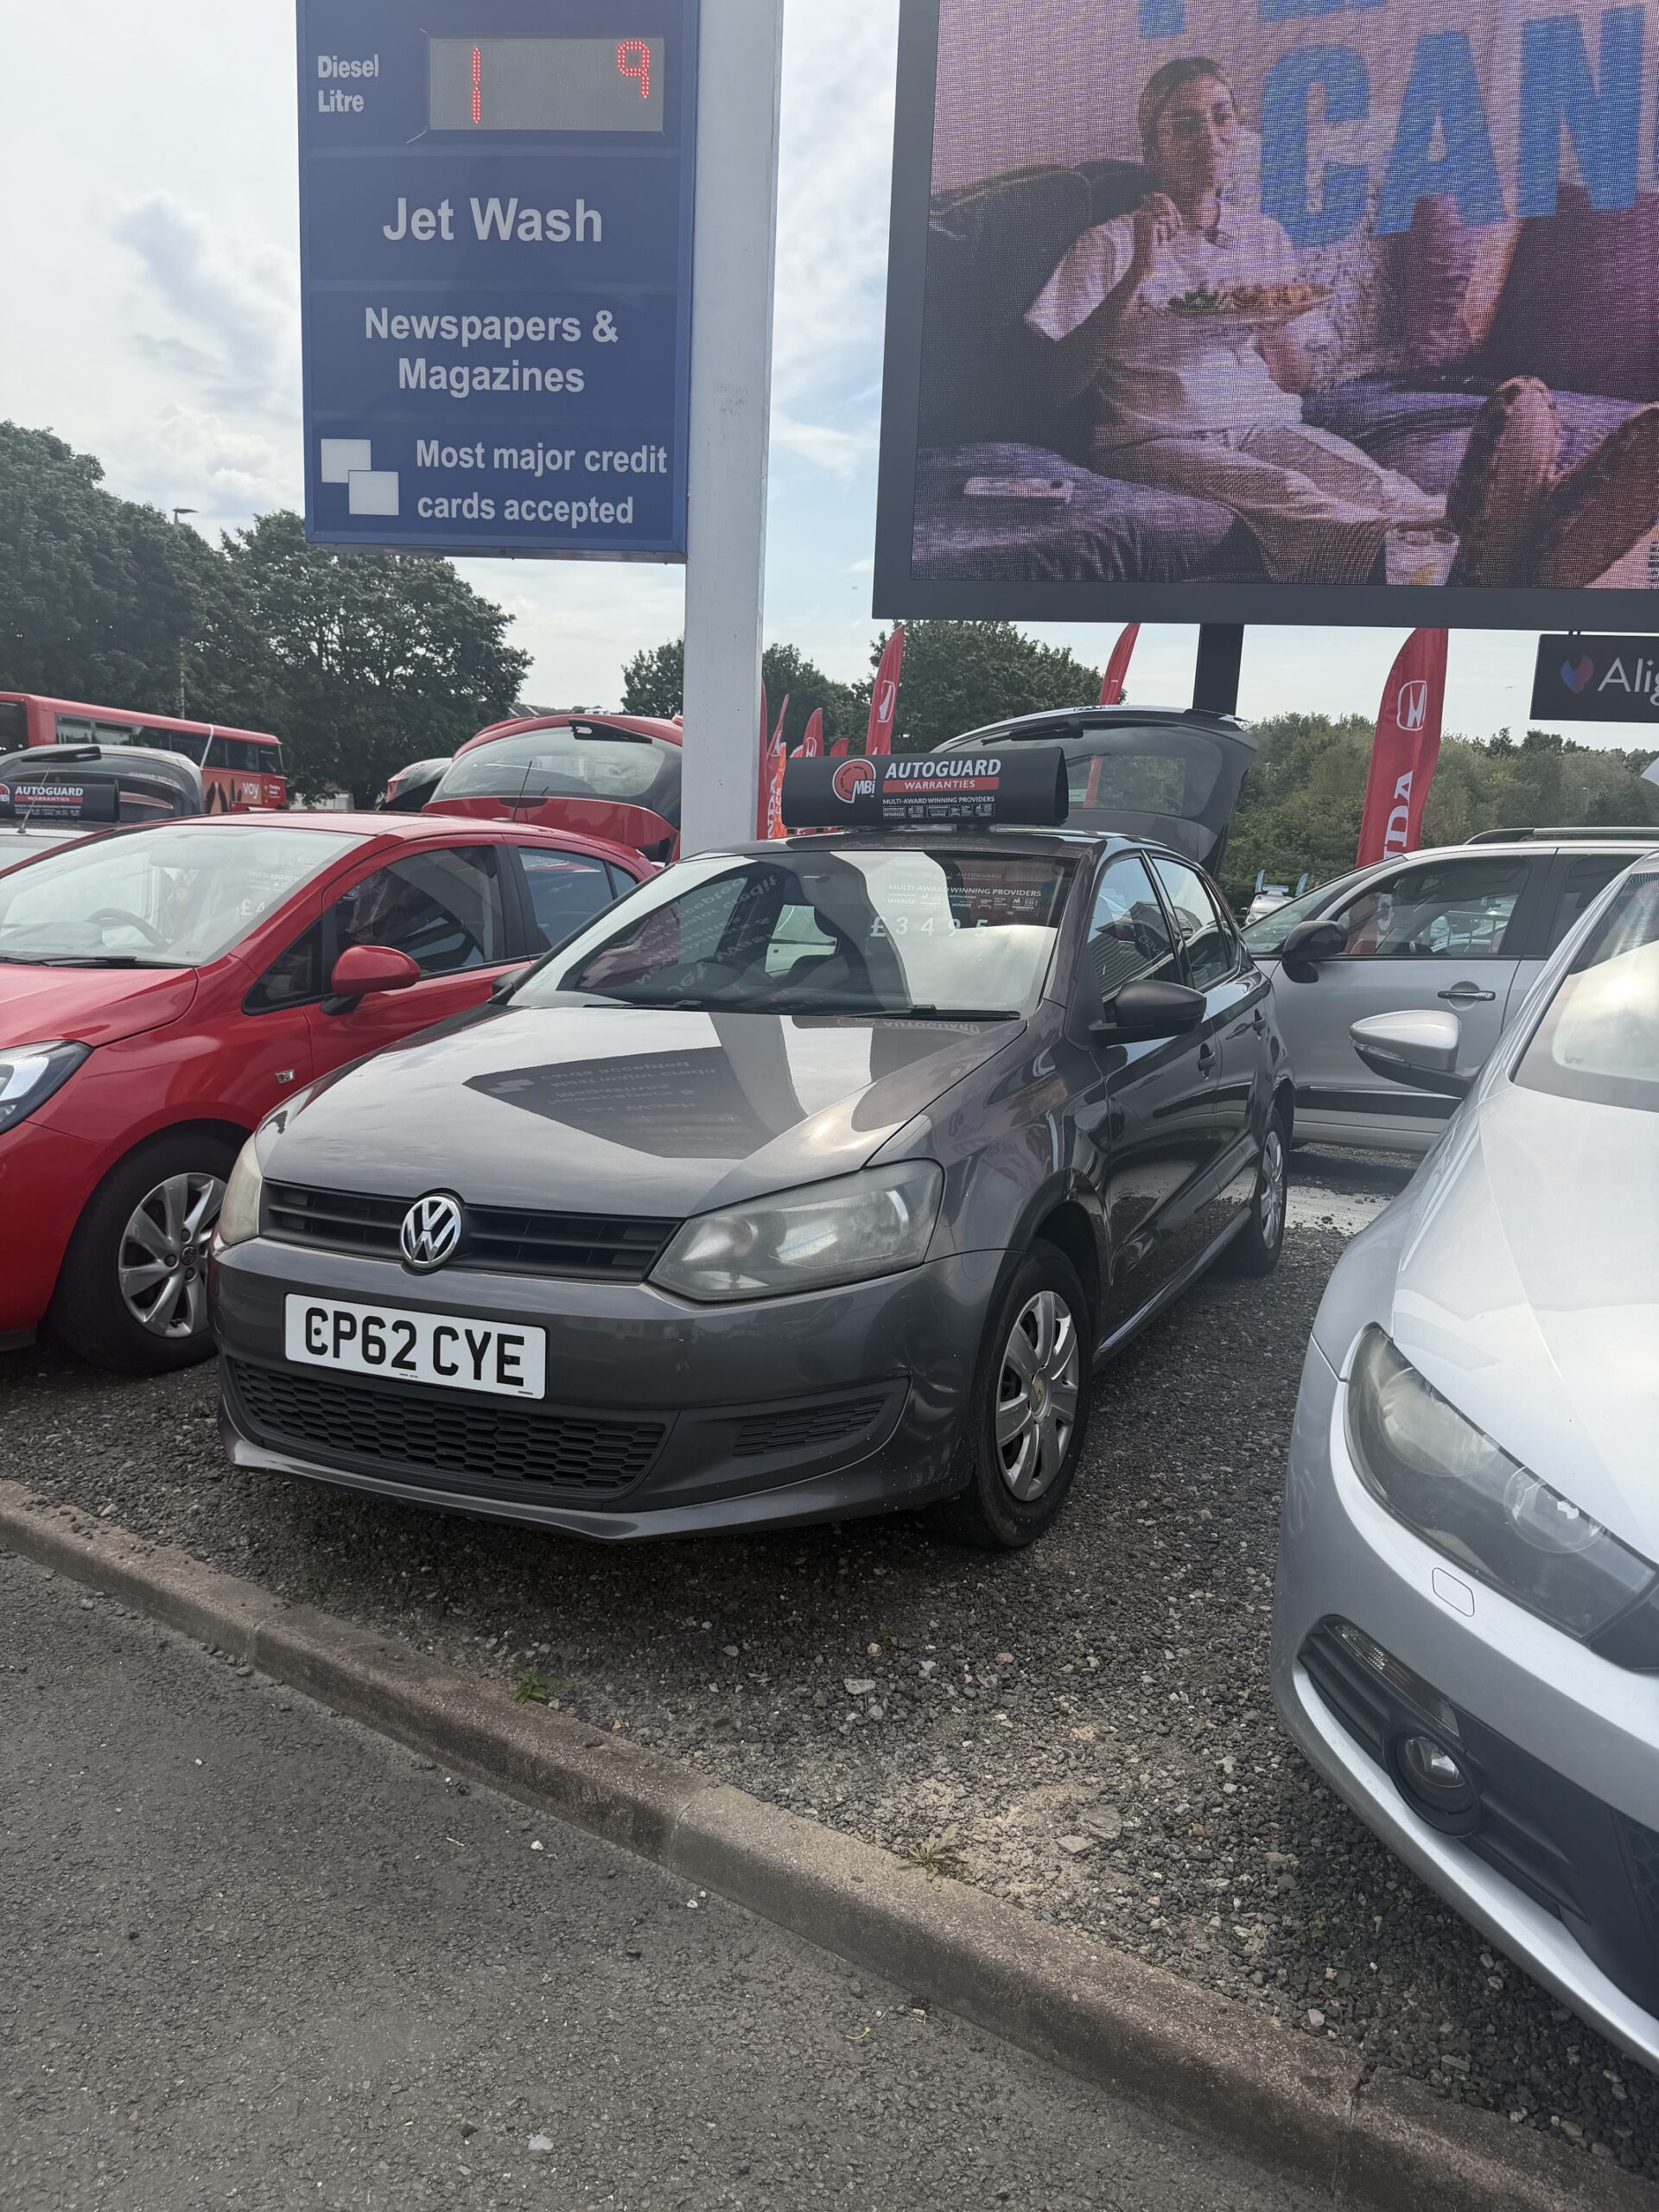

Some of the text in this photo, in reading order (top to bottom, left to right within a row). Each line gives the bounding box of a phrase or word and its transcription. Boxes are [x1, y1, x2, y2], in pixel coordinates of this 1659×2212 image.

[317, 54, 379, 79] Diesel
[617, 40, 650, 98] 9
[317, 90, 365, 112] Litre
[1260, 4, 1659, 247] CAN
[383, 197, 604, 243] Jet Wash
[365, 308, 619, 348] Newspapers &
[398, 358, 585, 398] Magazines
[416, 440, 668, 478] Most major credit
[417, 493, 633, 529] cards accepted
[884, 759, 1001, 779] AUTOGUARD
[15, 785, 84, 797] AUTOGUARD
[854, 779, 876, 795] MBi
[904, 779, 976, 790] WARRANTIES
[927, 796, 957, 804] WINNING
[887, 884, 1042, 898] MULTI-AWARD WINNING PROVIDERS
[305, 1306, 524, 1387] CP62 CYE
